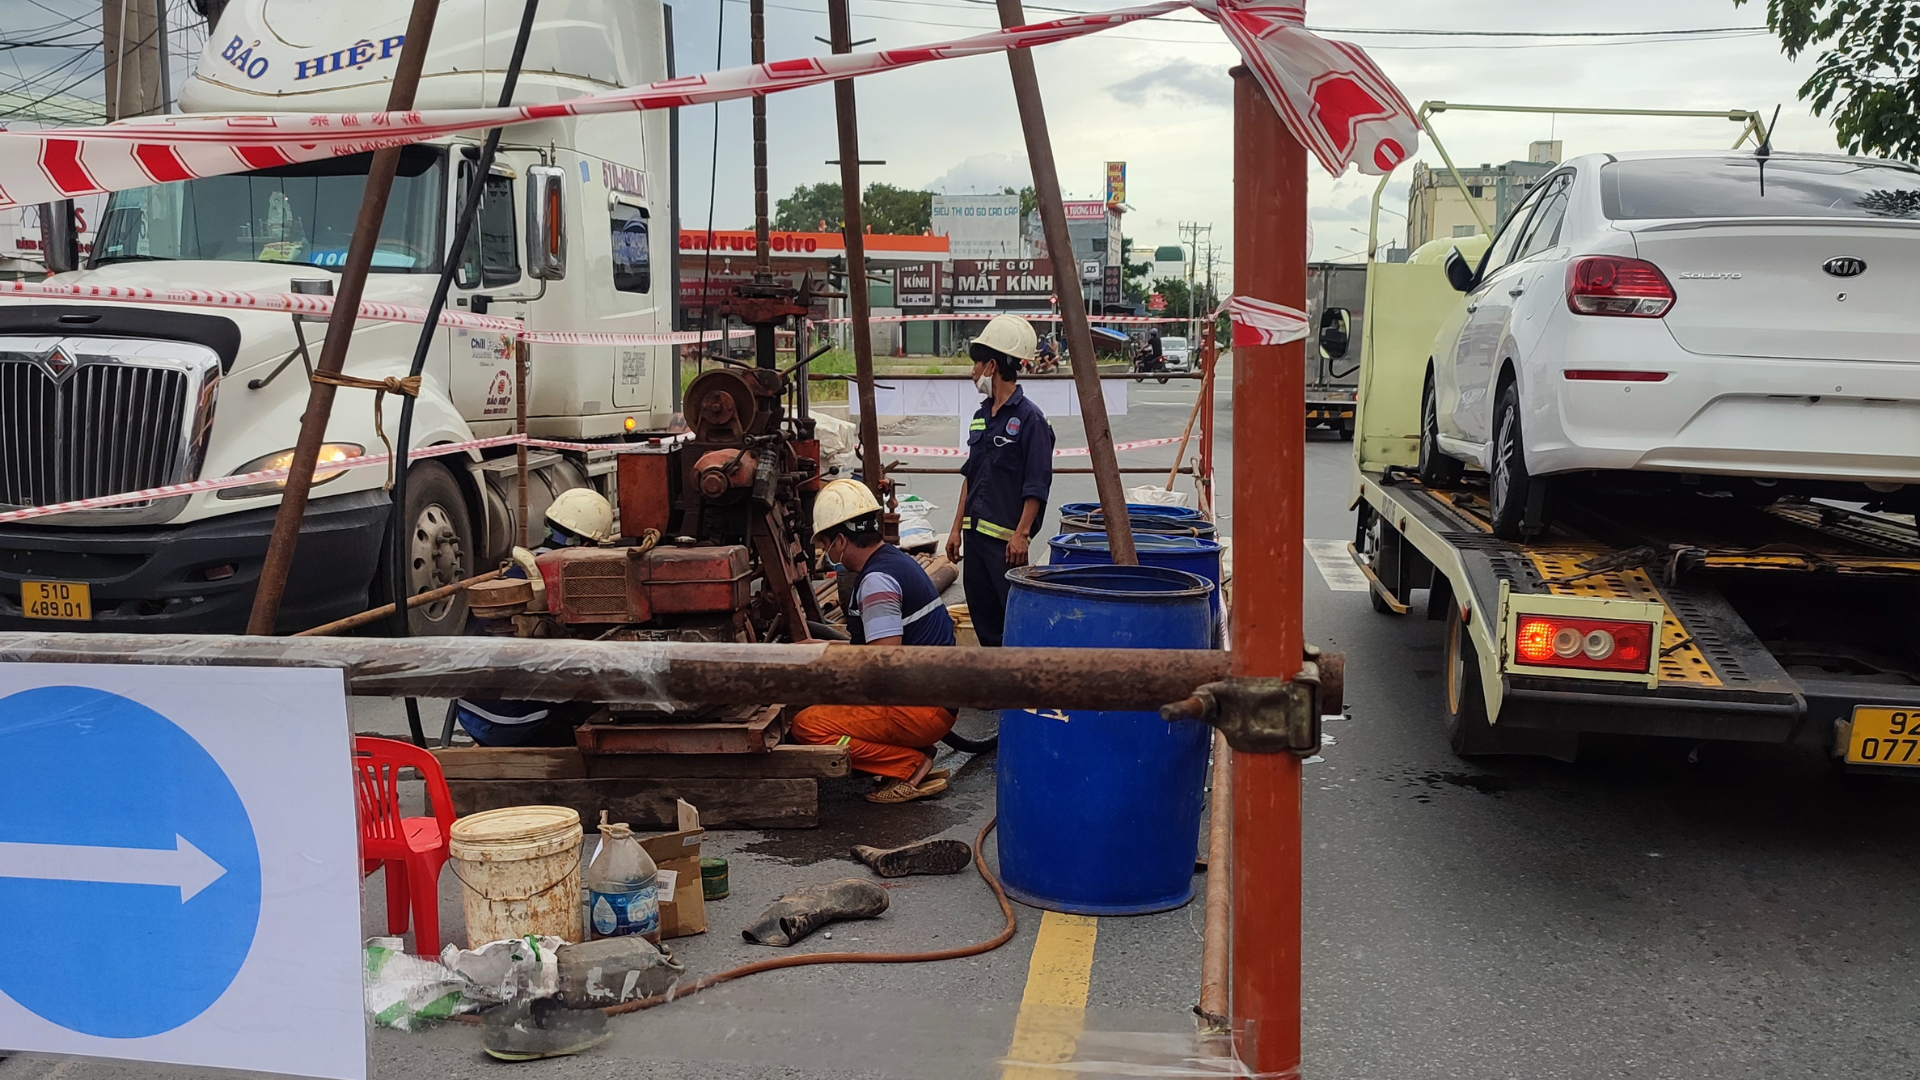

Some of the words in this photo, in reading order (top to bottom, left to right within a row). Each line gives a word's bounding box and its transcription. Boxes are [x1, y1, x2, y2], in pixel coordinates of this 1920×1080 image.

[222, 34, 268, 79] BẢO
[295, 35, 405, 80] HIỆP
[1831, 260, 1861, 274] KIA
[903, 273, 930, 289] KÍNH
[958, 269, 1000, 292] MẮT
[1006, 271, 1053, 292] KÍNH
[40, 583, 70, 600] 51D
[31, 600, 82, 618] 489.01
